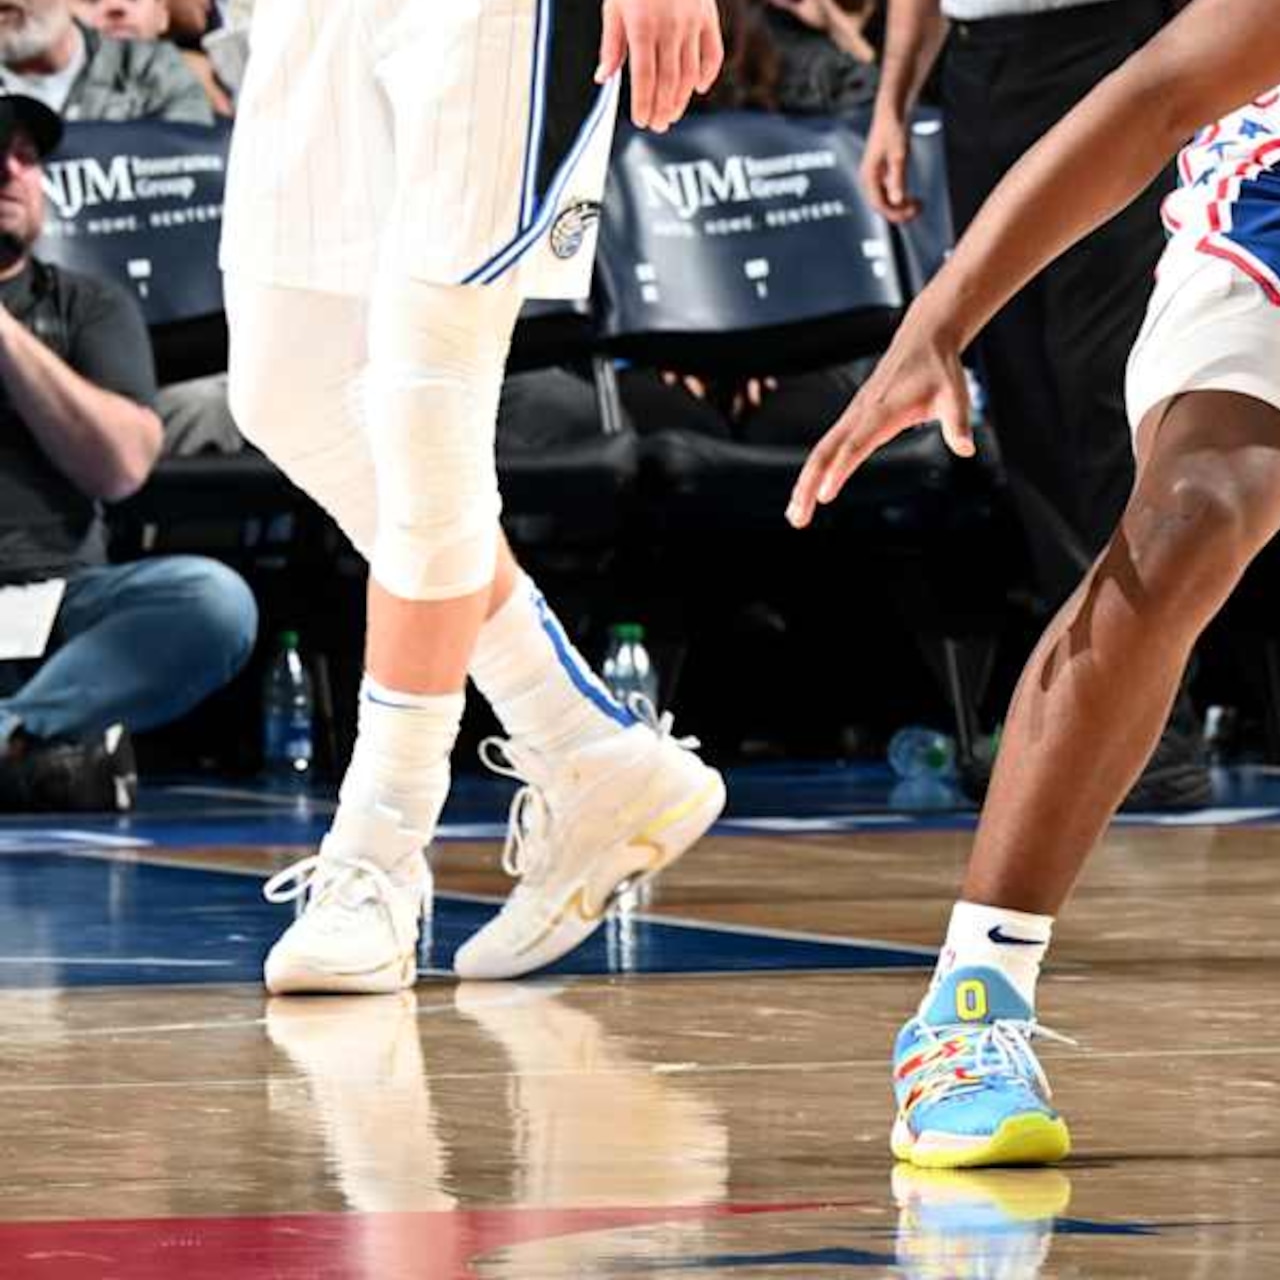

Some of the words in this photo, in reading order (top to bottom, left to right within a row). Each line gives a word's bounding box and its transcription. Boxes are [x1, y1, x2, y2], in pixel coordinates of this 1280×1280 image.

[40, 155, 138, 219] NJM
[642, 154, 751, 220] NJM
[955, 979, 989, 1021] 0
